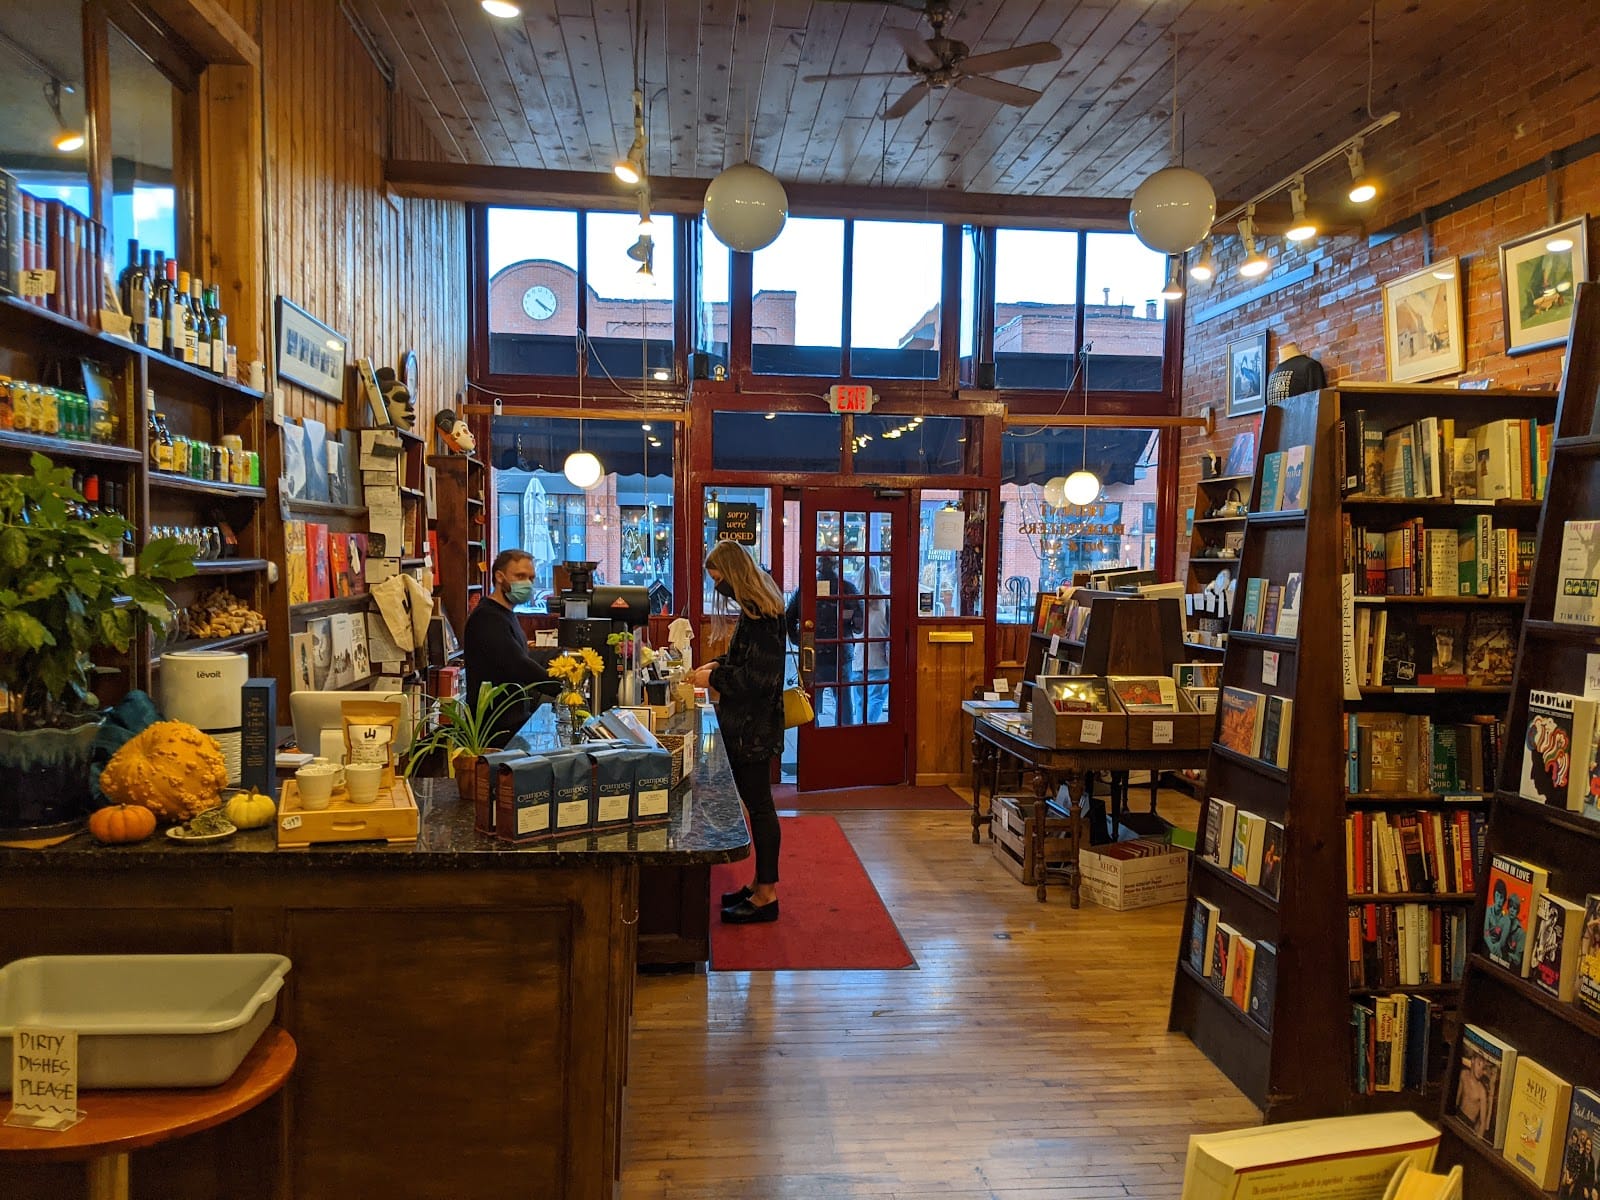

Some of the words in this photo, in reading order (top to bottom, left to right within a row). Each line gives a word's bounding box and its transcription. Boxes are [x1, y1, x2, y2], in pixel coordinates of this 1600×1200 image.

[837, 386, 867, 410] EXIT
[719, 531, 754, 540] CLOSED
[1342, 578, 1351, 628] World
[1560, 612, 1572, 620] TIM
[1575, 613, 1595, 622] RILEY
[1343, 632, 1352, 685] History
[1531, 692, 1545, 705] BOB
[1546, 694, 1573, 710] DYLAN
[1492, 857, 1510, 873] REMAIN
[1516, 868, 1530, 882] LOVE
[20, 1032, 65, 1055] DIRTY
[18, 1055, 71, 1076] DISHES
[20, 1079, 75, 1100] PLEASE
